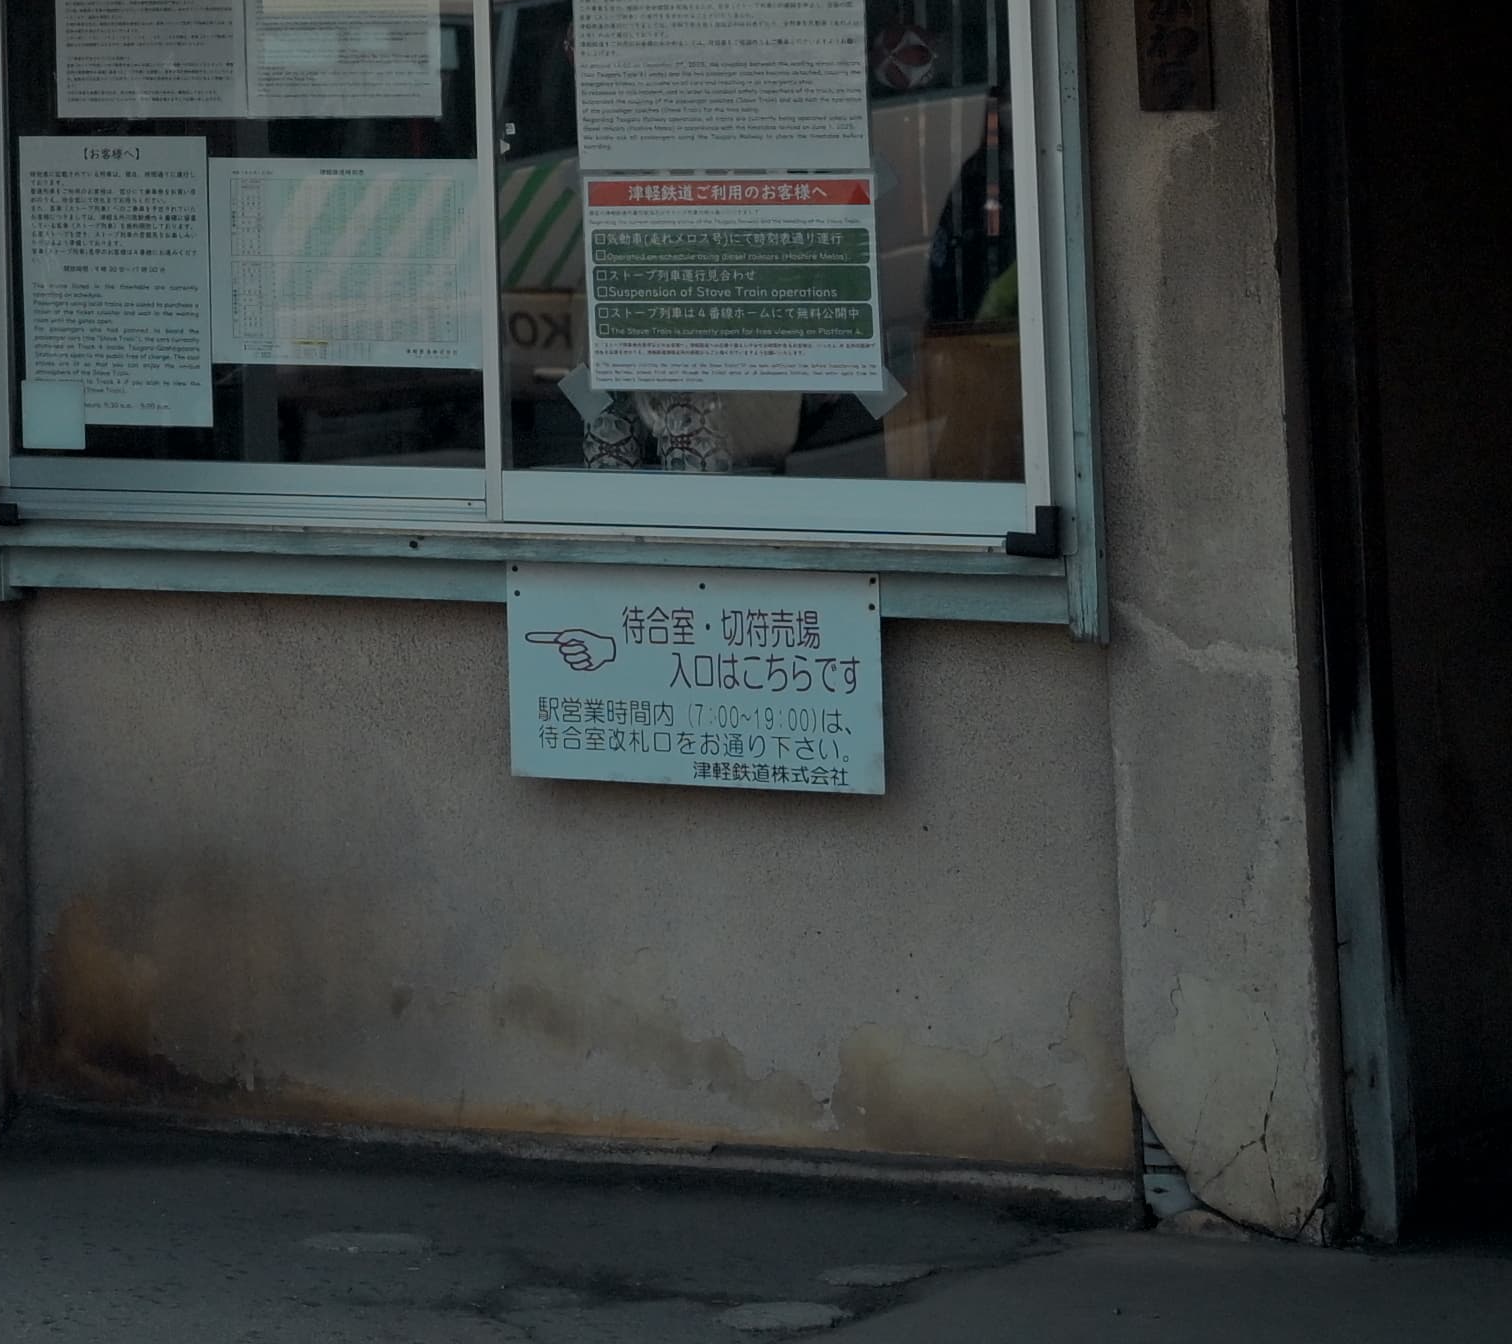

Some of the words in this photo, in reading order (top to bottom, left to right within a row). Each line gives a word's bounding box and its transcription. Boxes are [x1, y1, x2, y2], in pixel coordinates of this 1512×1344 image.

[628, 184, 828, 202] 津軽鉄道ご利用のお客様へ
[608, 286, 677, 299] Suspension
[680, 286, 692, 297] of
[696, 286, 731, 297] Stove
[736, 287, 767, 297] Train
[771, 287, 837, 300] operations
[622, 606, 820, 649] 待合室・切符売場
[669, 653, 860, 694] 入口はこちらです
[538, 697, 674, 725] 駅営業時間内
[539, 726, 850, 763] 待合室改札口をお通り下さい。
[693, 761, 850, 787] 津軽鉄道株式会社
